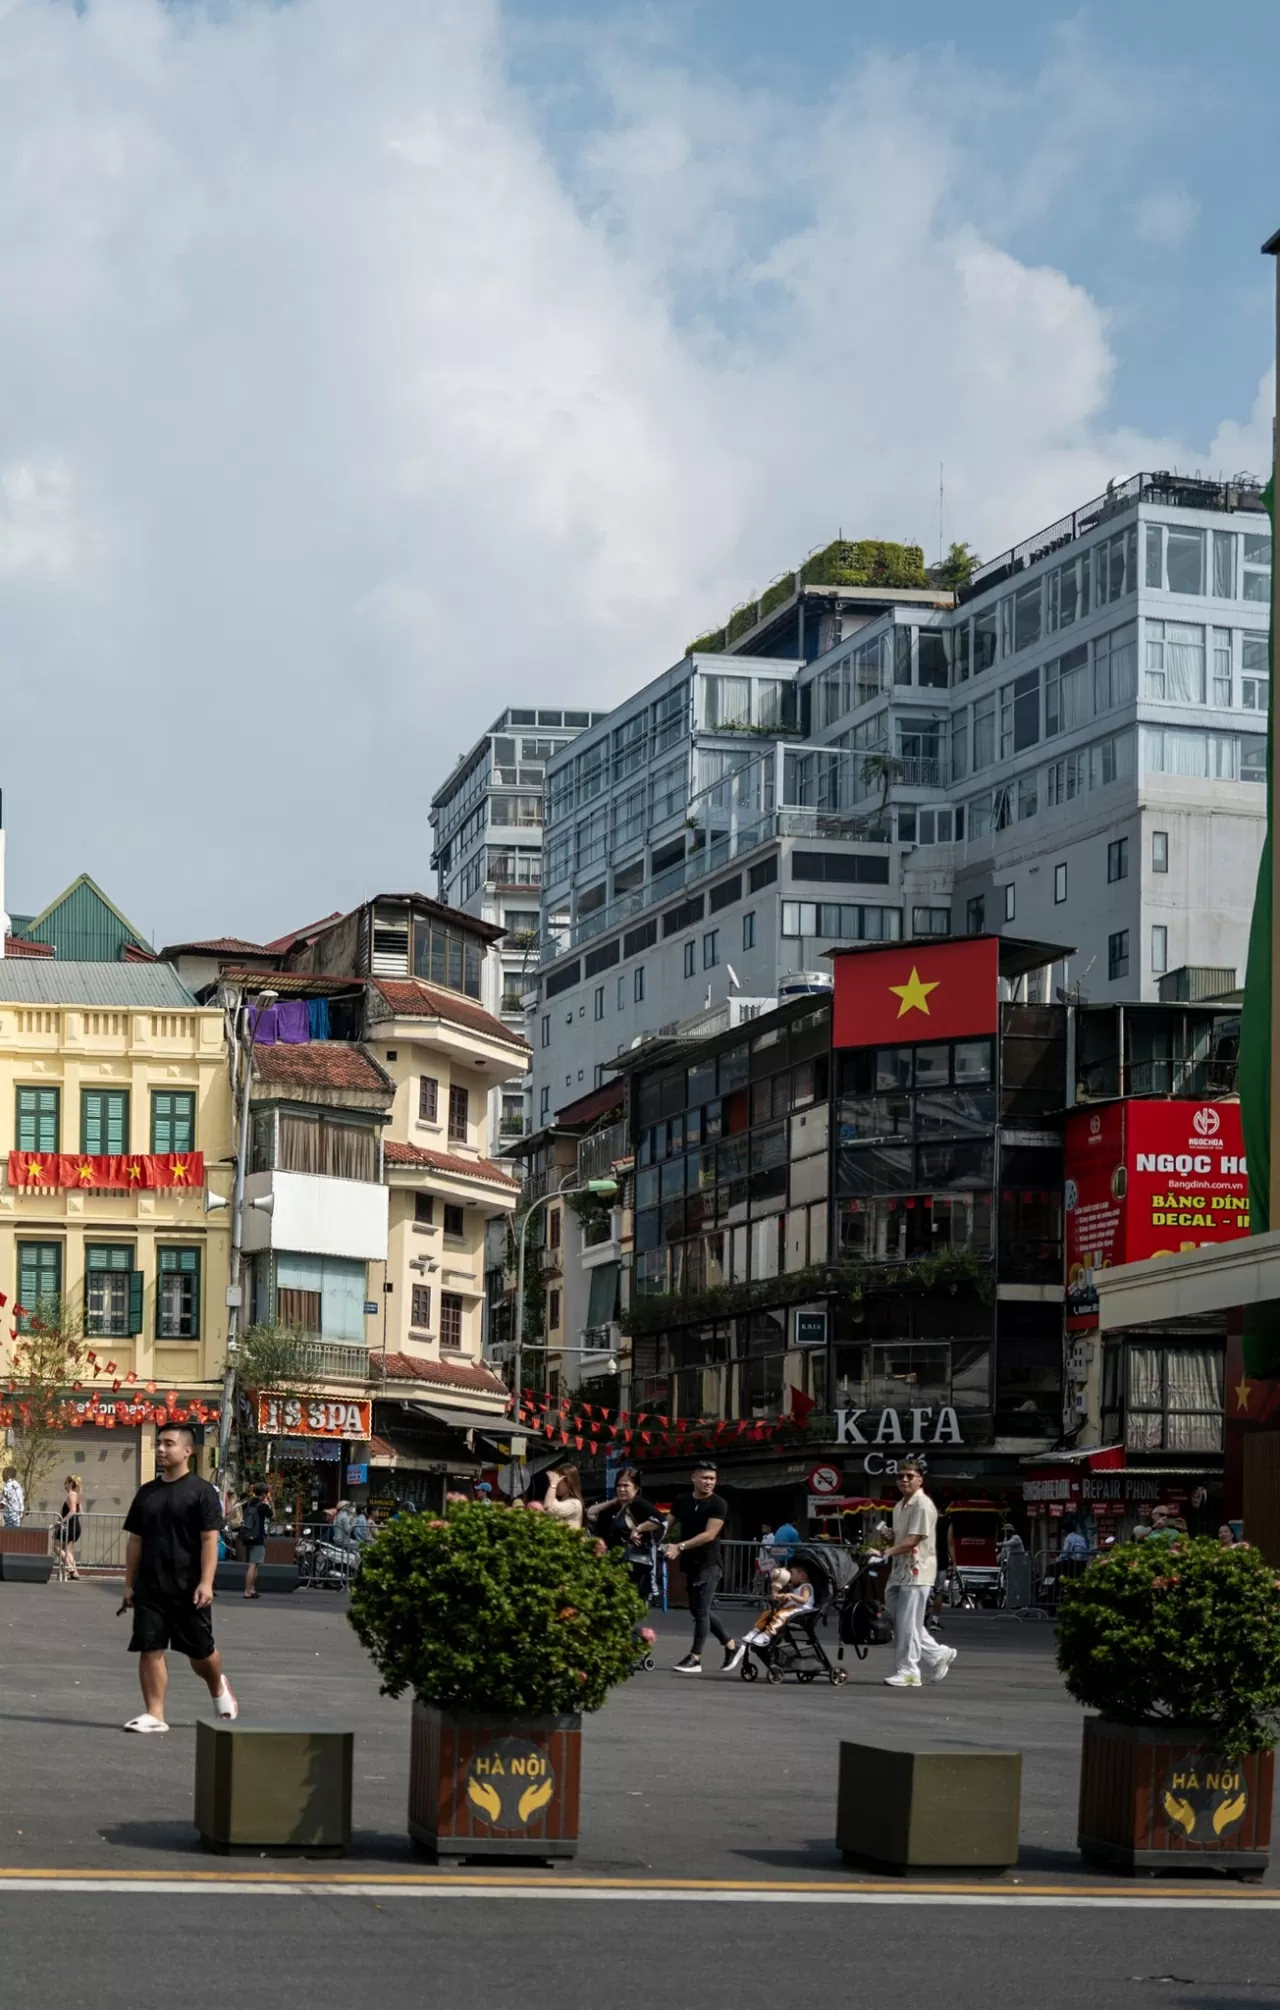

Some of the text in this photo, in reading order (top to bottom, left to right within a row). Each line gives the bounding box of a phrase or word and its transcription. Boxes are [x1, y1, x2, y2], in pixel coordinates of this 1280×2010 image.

[1136, 1153, 1212, 1176] NGỌC
[1168, 1179, 1243, 1190] Bangdinh.com.vn
[1152, 1192, 1206, 1208] BĂNG
[1152, 1212, 1216, 1227] DECAL
[308, 1401, 364, 1432] SPA
[833, 1407, 965, 1444] KAFA
[1082, 1478, 1121, 1500] REPAIR
[1124, 1479, 1161, 1500] PHONE
[477, 1752, 546, 1780] HÀ NỘI
[1172, 1768, 1240, 1795] HÀ NỘI
